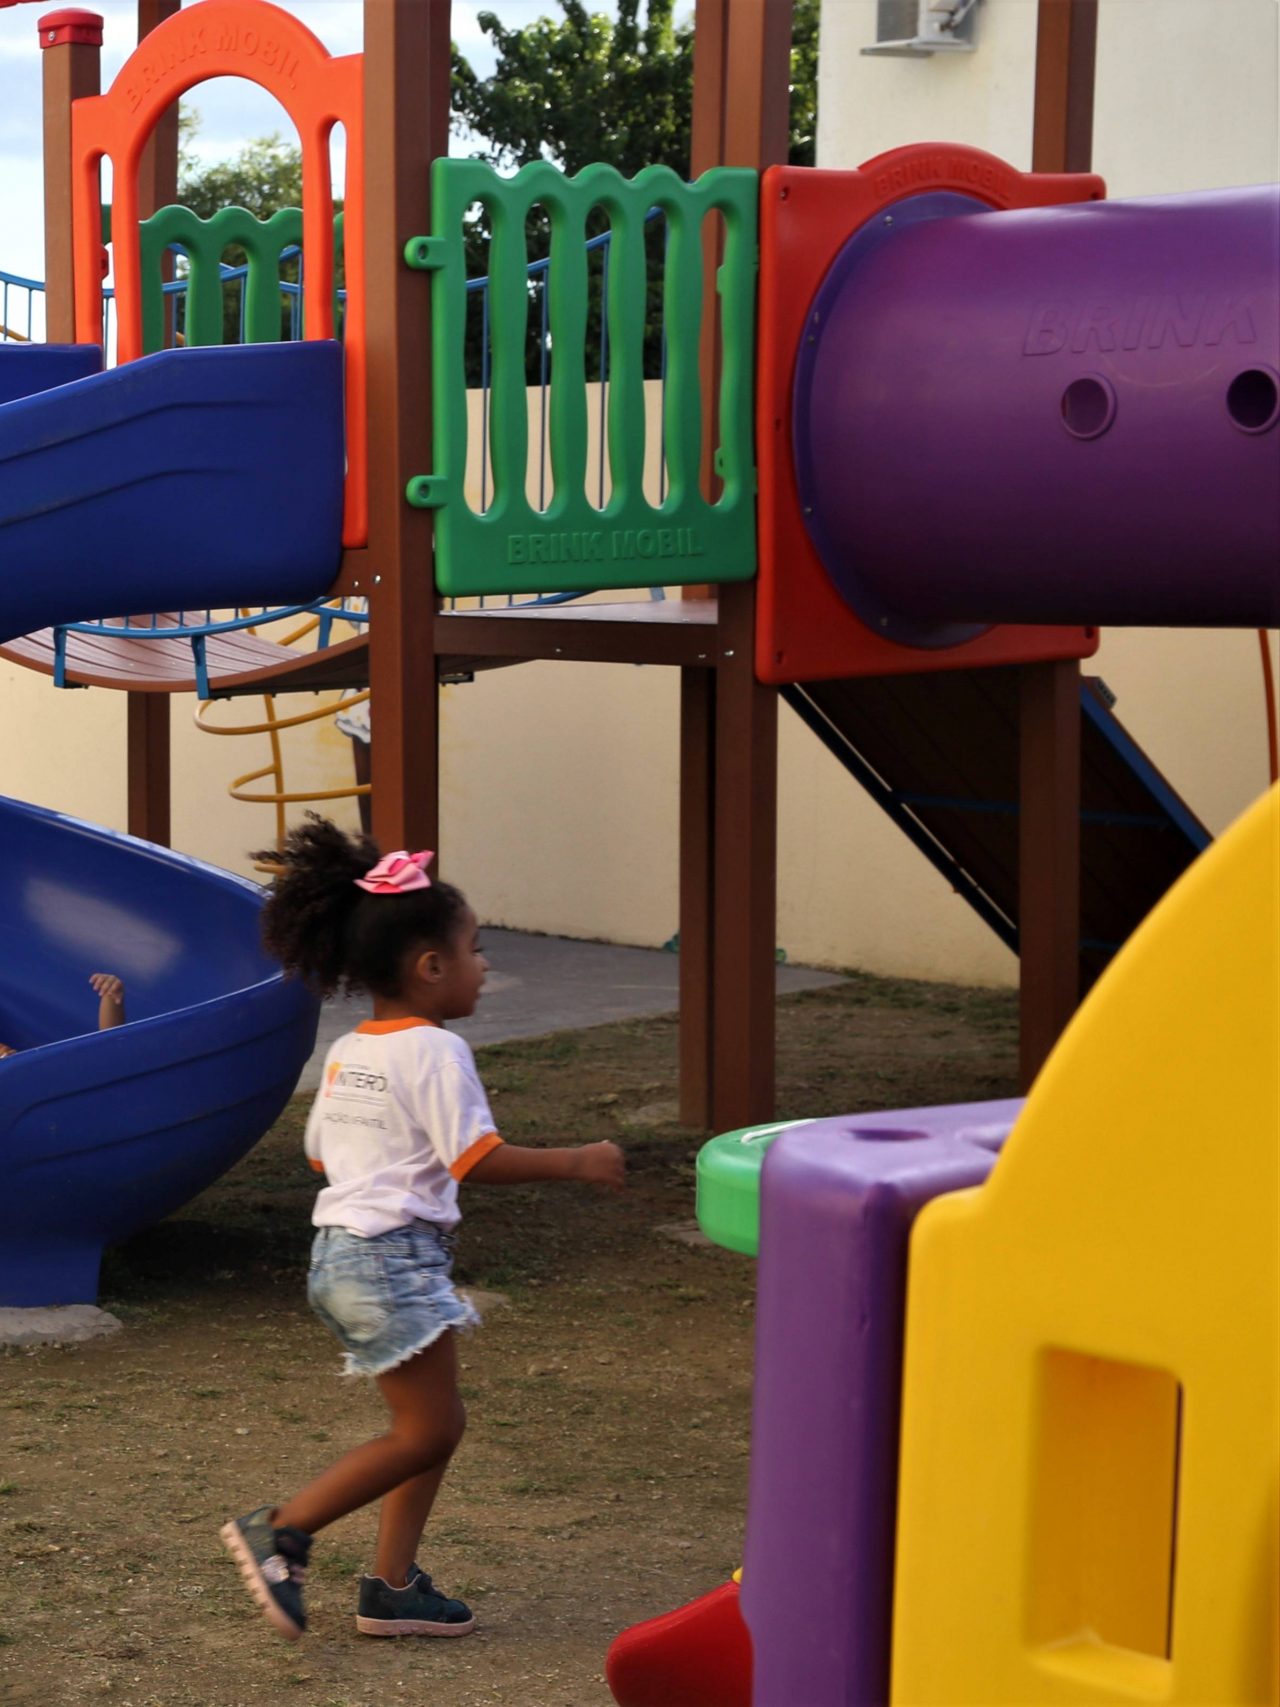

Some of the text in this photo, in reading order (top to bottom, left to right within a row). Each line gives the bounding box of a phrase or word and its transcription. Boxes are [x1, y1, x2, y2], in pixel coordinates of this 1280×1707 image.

[215, 24, 302, 91] MOBIL
[873, 156, 942, 199] BRINK
[1022, 293, 1258, 357] BRINK
[507, 527, 705, 566] BRINK MOBIL
